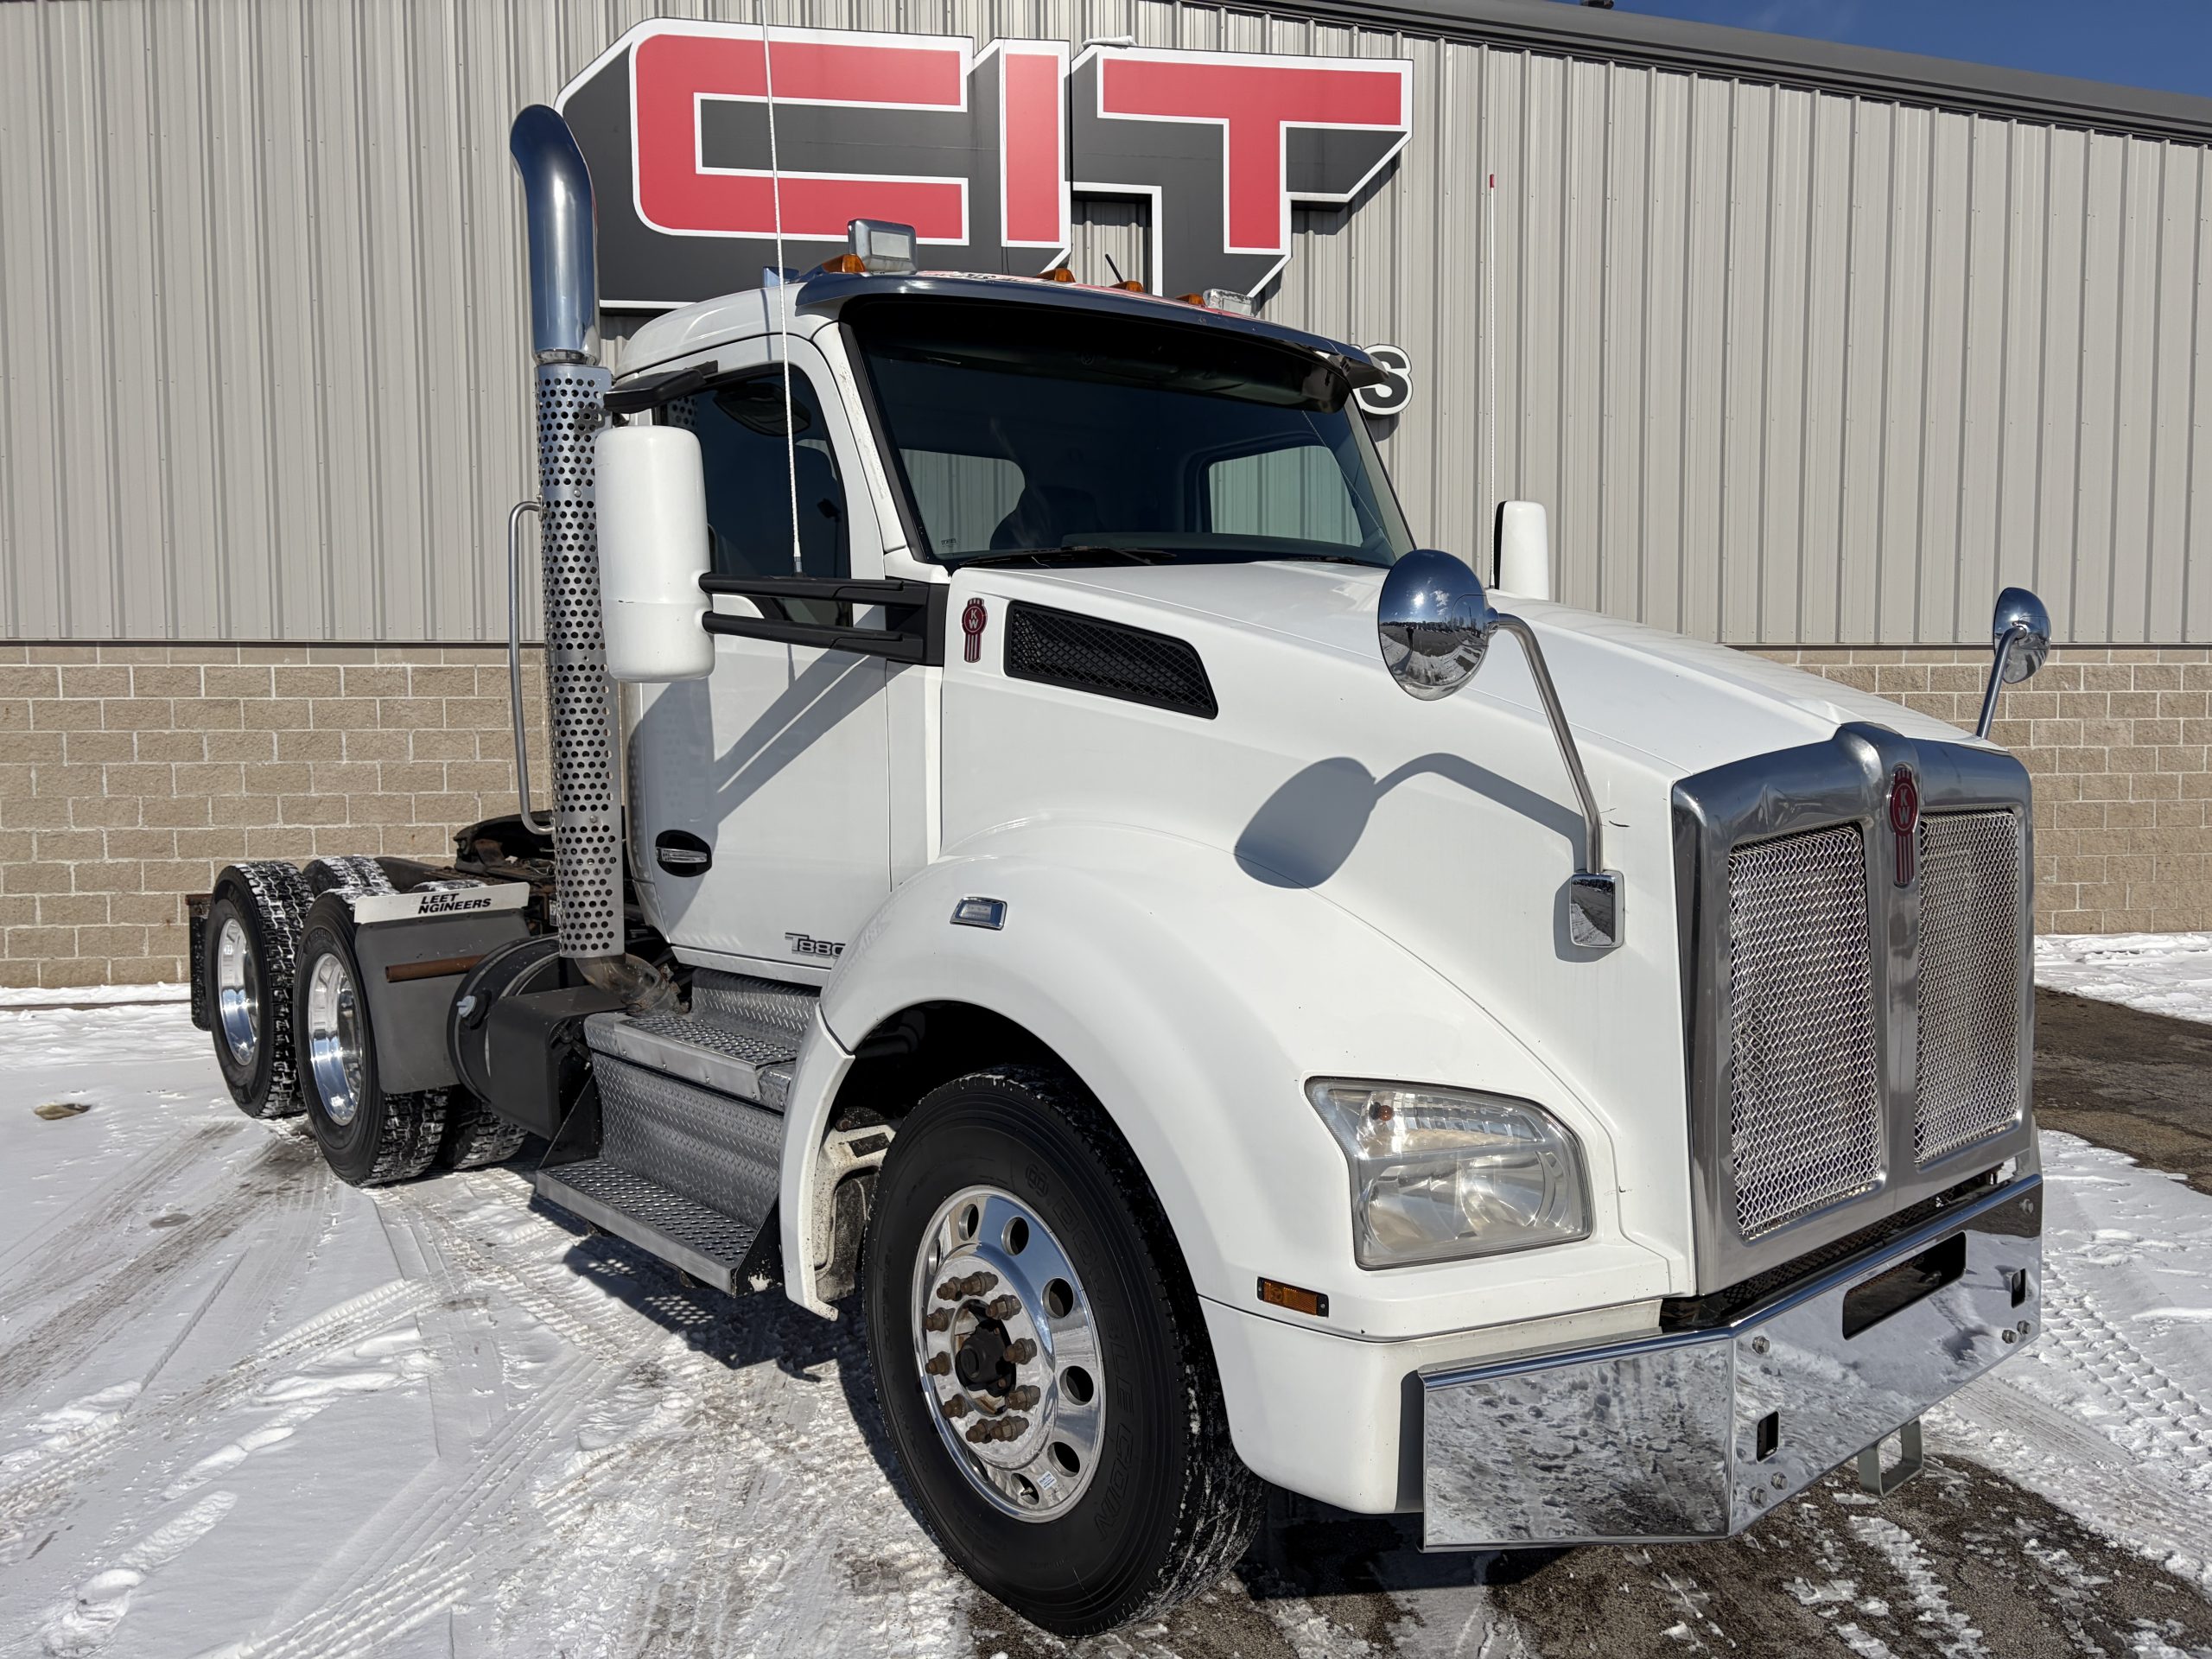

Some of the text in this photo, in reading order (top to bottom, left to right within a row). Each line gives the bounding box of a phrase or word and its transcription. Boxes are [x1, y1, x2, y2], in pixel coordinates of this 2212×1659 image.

[628, 18, 1413, 256] CIT
[417, 898, 492, 914] NGINEERS
[421, 893, 460, 905] LEET
[1052, 1196, 1135, 1542] DOUBLE COIN
